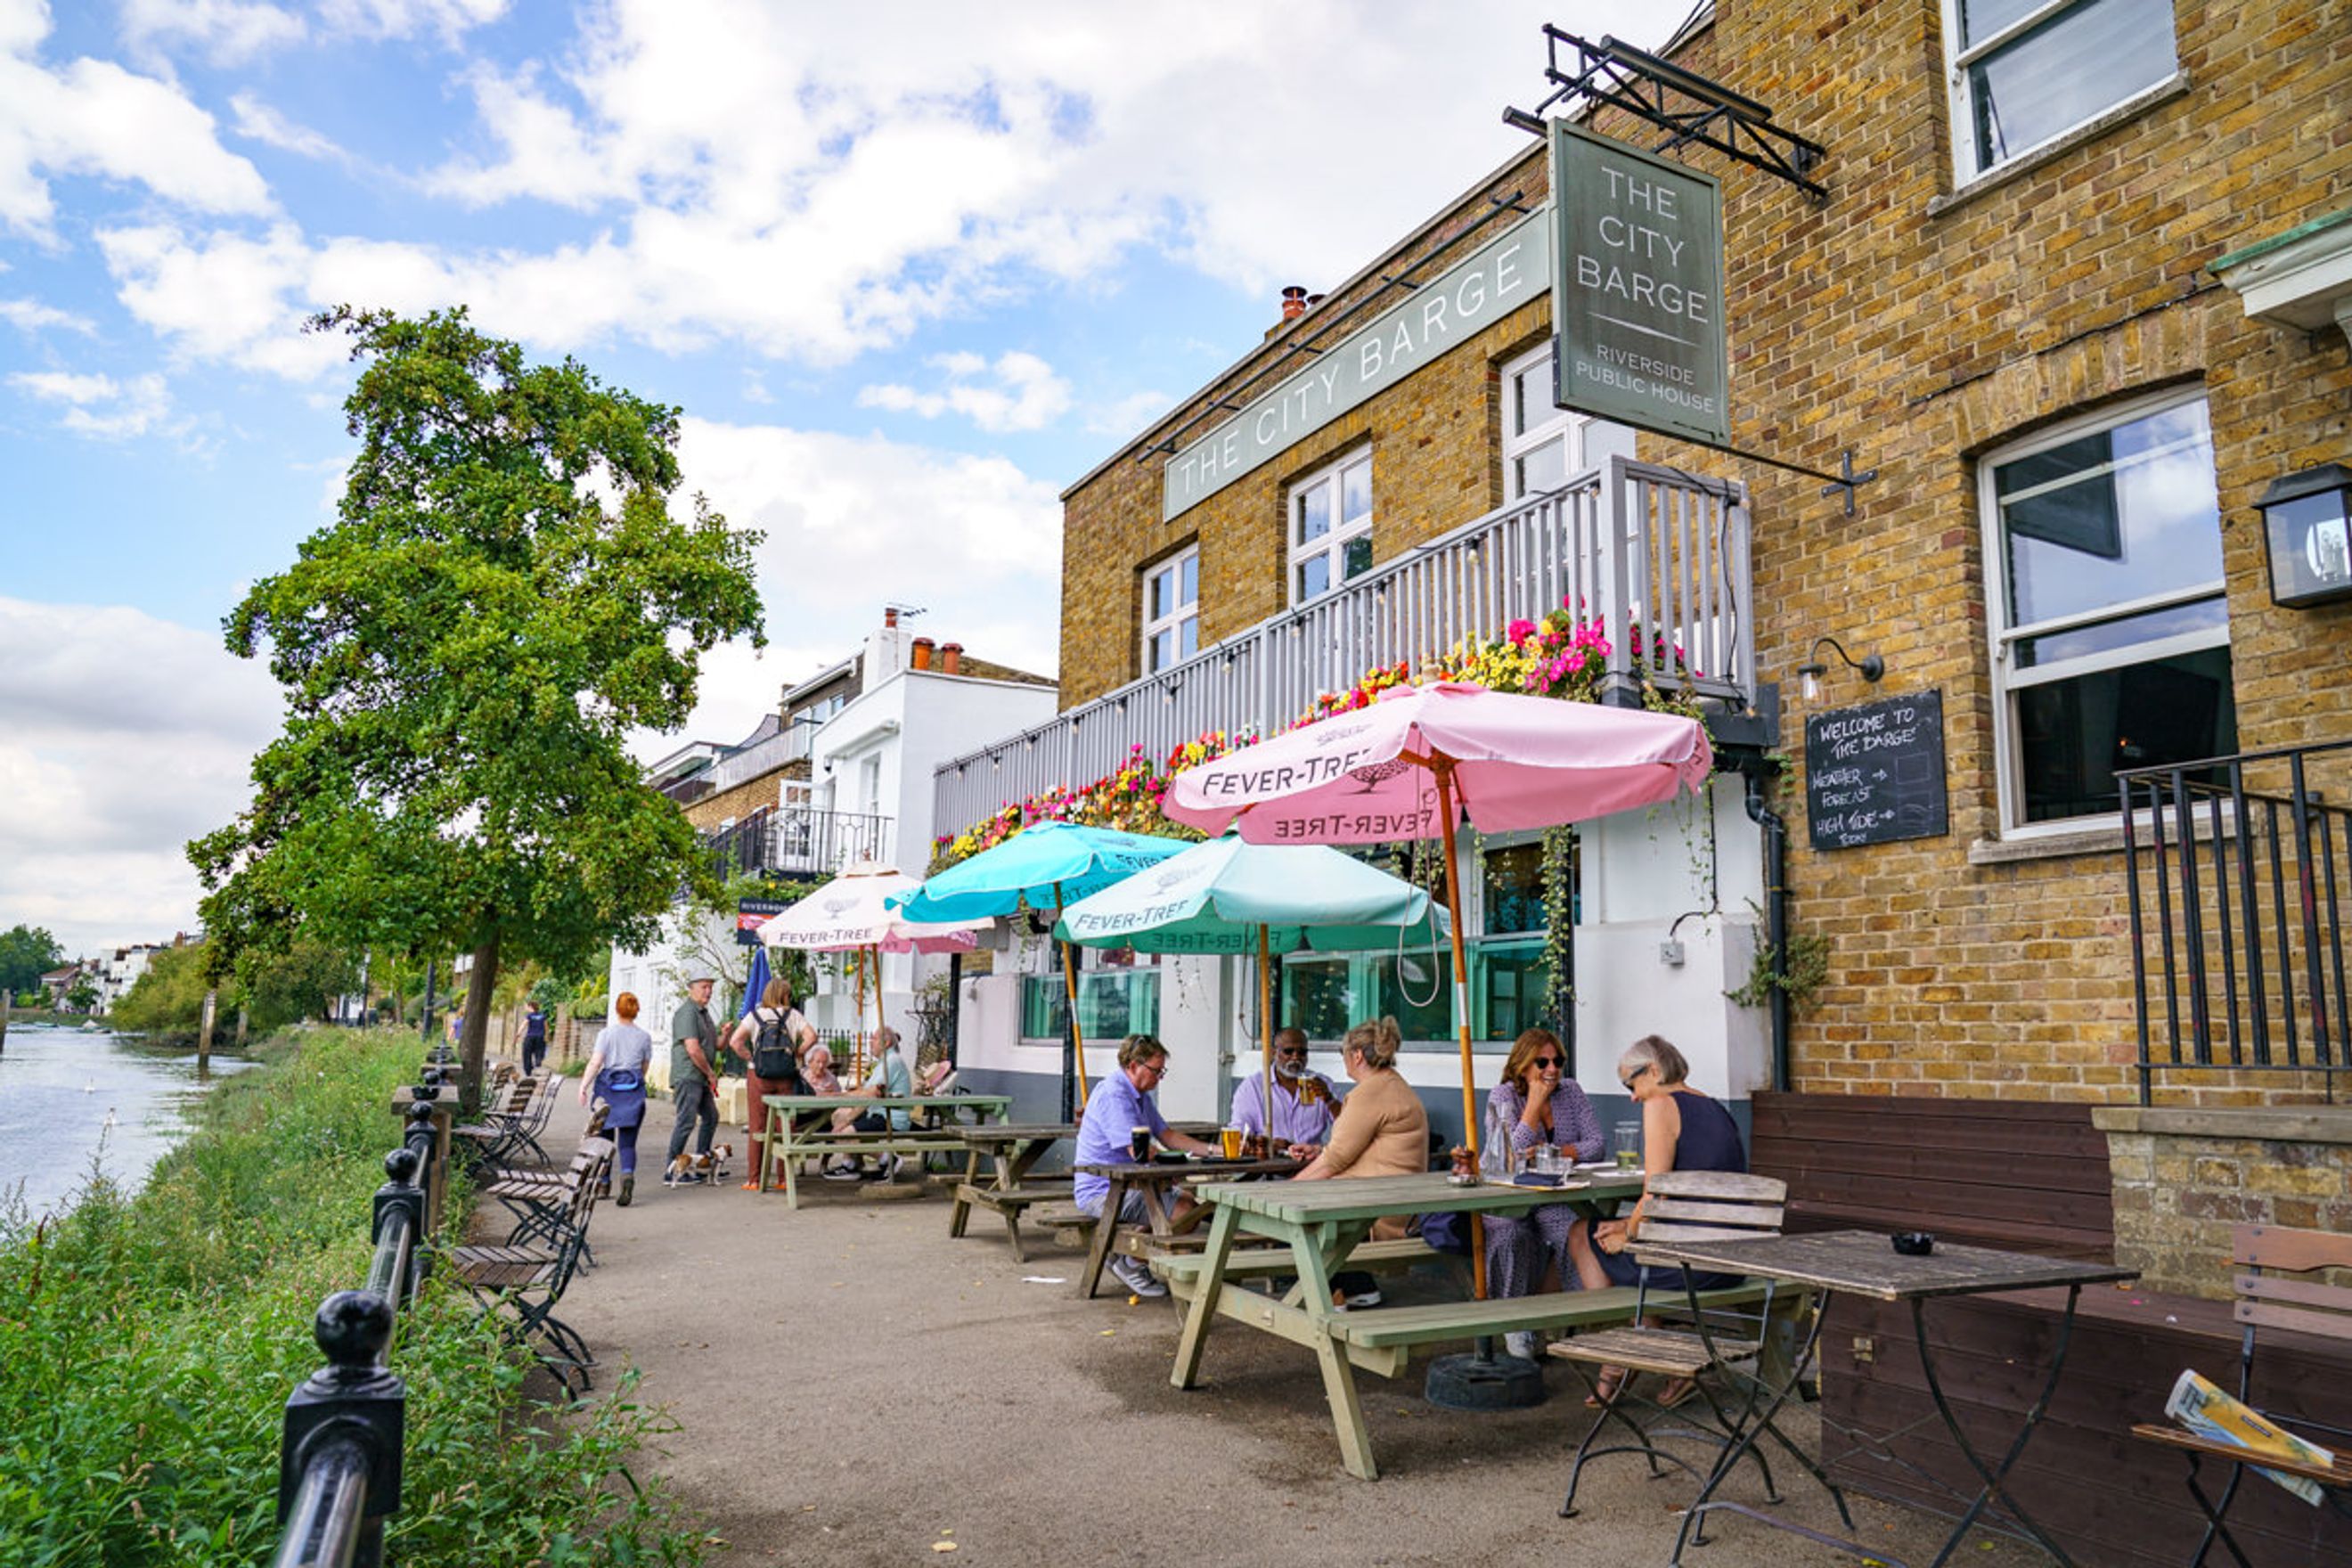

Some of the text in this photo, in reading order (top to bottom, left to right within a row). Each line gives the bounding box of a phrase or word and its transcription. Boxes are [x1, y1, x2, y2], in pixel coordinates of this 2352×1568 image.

[1602, 167, 1677, 220] THE
[1598, 216, 1685, 267] CITY
[1577, 255, 1709, 324] BARGE
[1180, 244, 1522, 495] THE CITY BARGE
[1597, 344, 1694, 385] RIVERSIDE
[1576, 362, 1714, 413] PUBLIC HOUSE
[1820, 707, 1915, 742] WELCOME TO
[1831, 727, 1916, 760] THE BARGE
[1812, 768, 1864, 789] WEATHER
[1822, 785, 1874, 808] FORECAST
[1816, 809, 1879, 836] HIGH TIDE
[780, 927, 872, 943] FEVER-TREE
